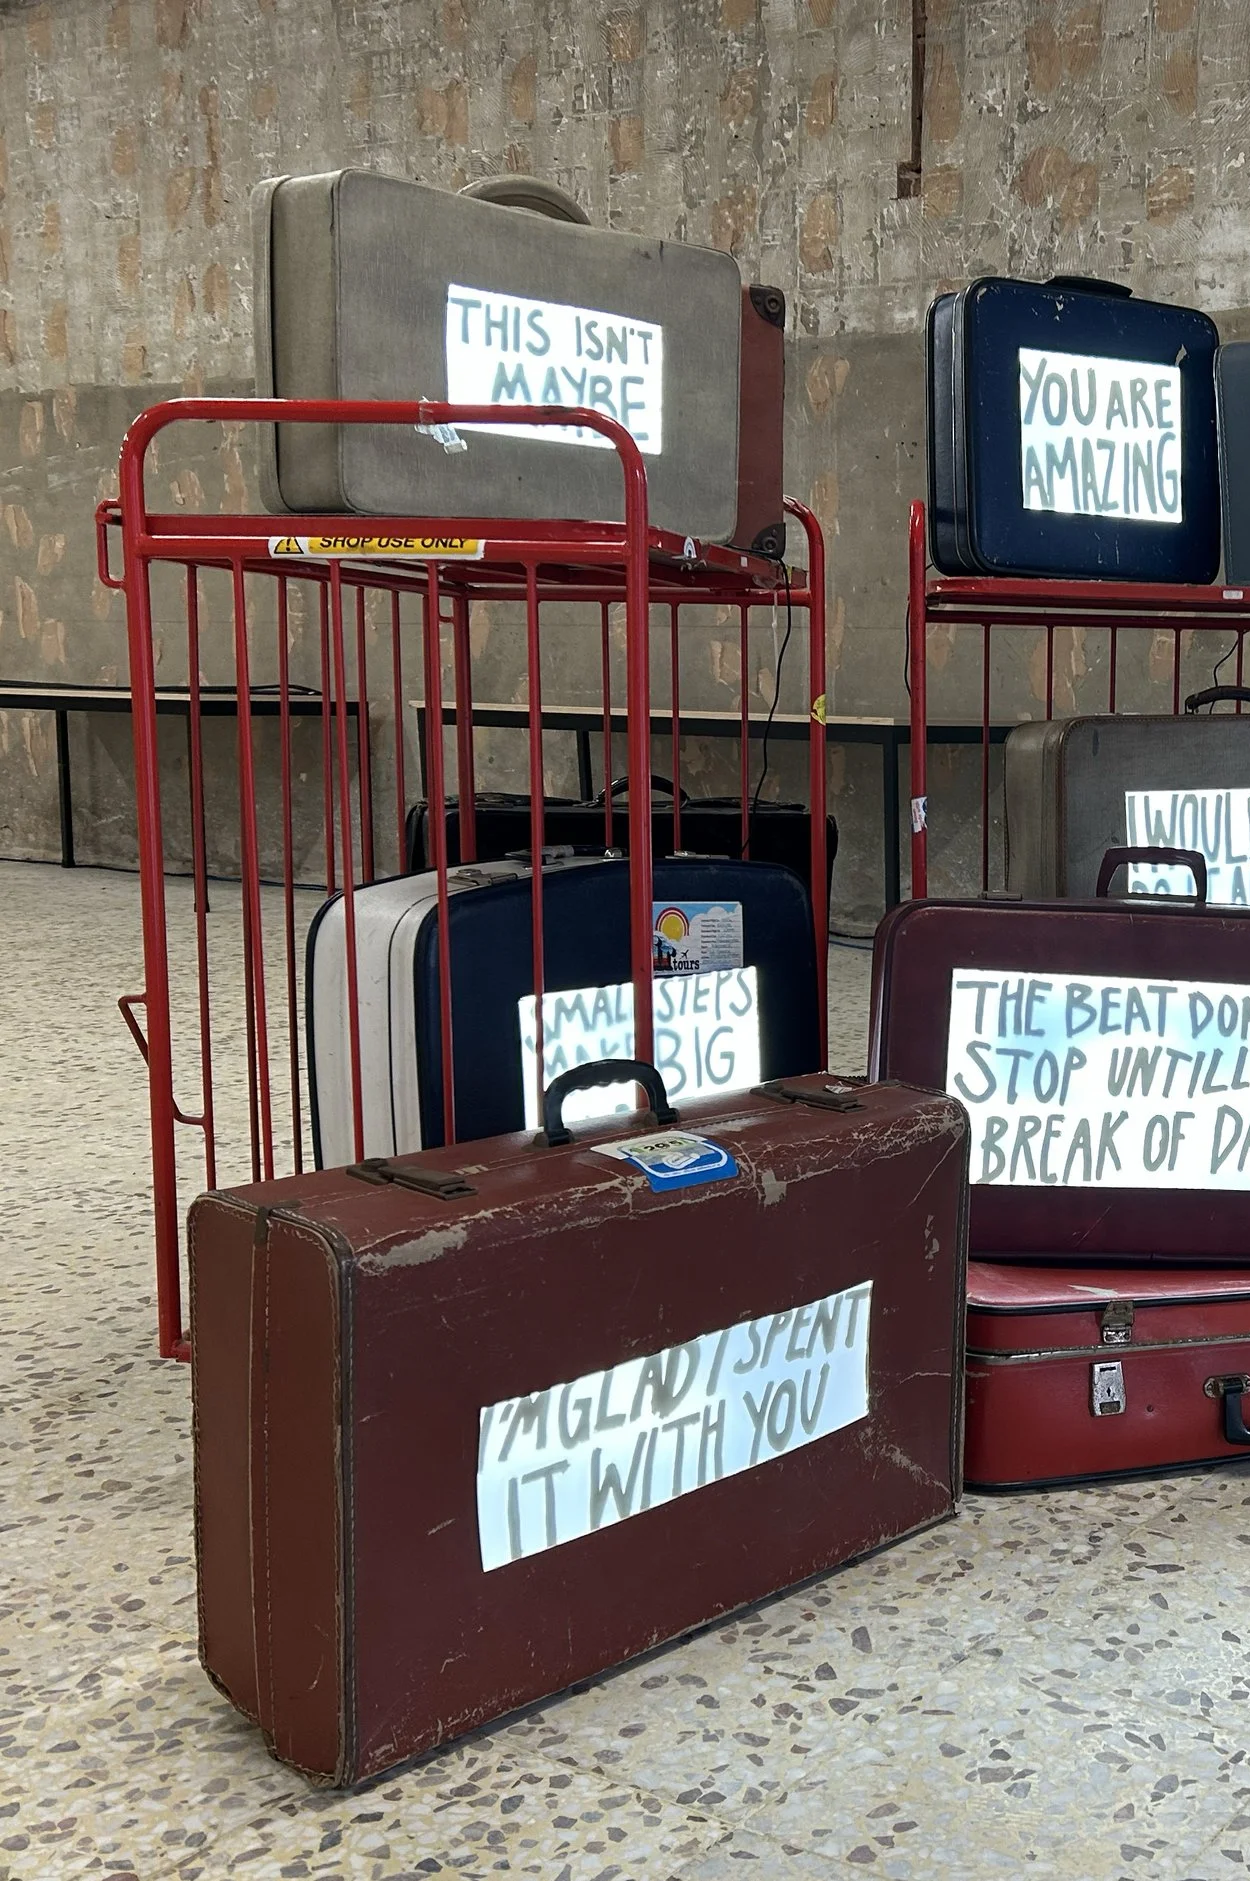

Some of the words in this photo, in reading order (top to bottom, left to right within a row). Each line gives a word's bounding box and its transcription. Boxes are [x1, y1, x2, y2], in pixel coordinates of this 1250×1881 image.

[449, 297, 551, 357] THIS
[575, 316, 653, 365] ISN'T
[491, 361, 649, 441] MAYBE
[1020, 357, 1097, 427] YOU
[1105, 378, 1174, 431] ARE
[1024, 431, 1179, 514] AMAZING
[320, 537, 373, 549] SHOP
[377, 537, 416, 549] USE
[420, 538, 467, 549] ONLY
[655, 968, 753, 1023] STEPS
[672, 959, 700, 971] tours
[955, 978, 1053, 1039] THE
[1065, 982, 1179, 1039] BEAT
[654, 1026, 735, 1098] BIG
[953, 1039, 1087, 1106] STOP
[1107, 1045, 1250, 1099] UNTILL
[976, 1110, 1129, 1185] BREAK
[1142, 1110, 1196, 1172] OF
[557, 1340, 700, 1450] GLAD
[705, 1330, 731, 1397] I
[733, 1287, 872, 1375] SPENT
[508, 1460, 571, 1560] IT
[590, 1399, 726, 1531] WITH
[743, 1362, 830, 1467] YOU
